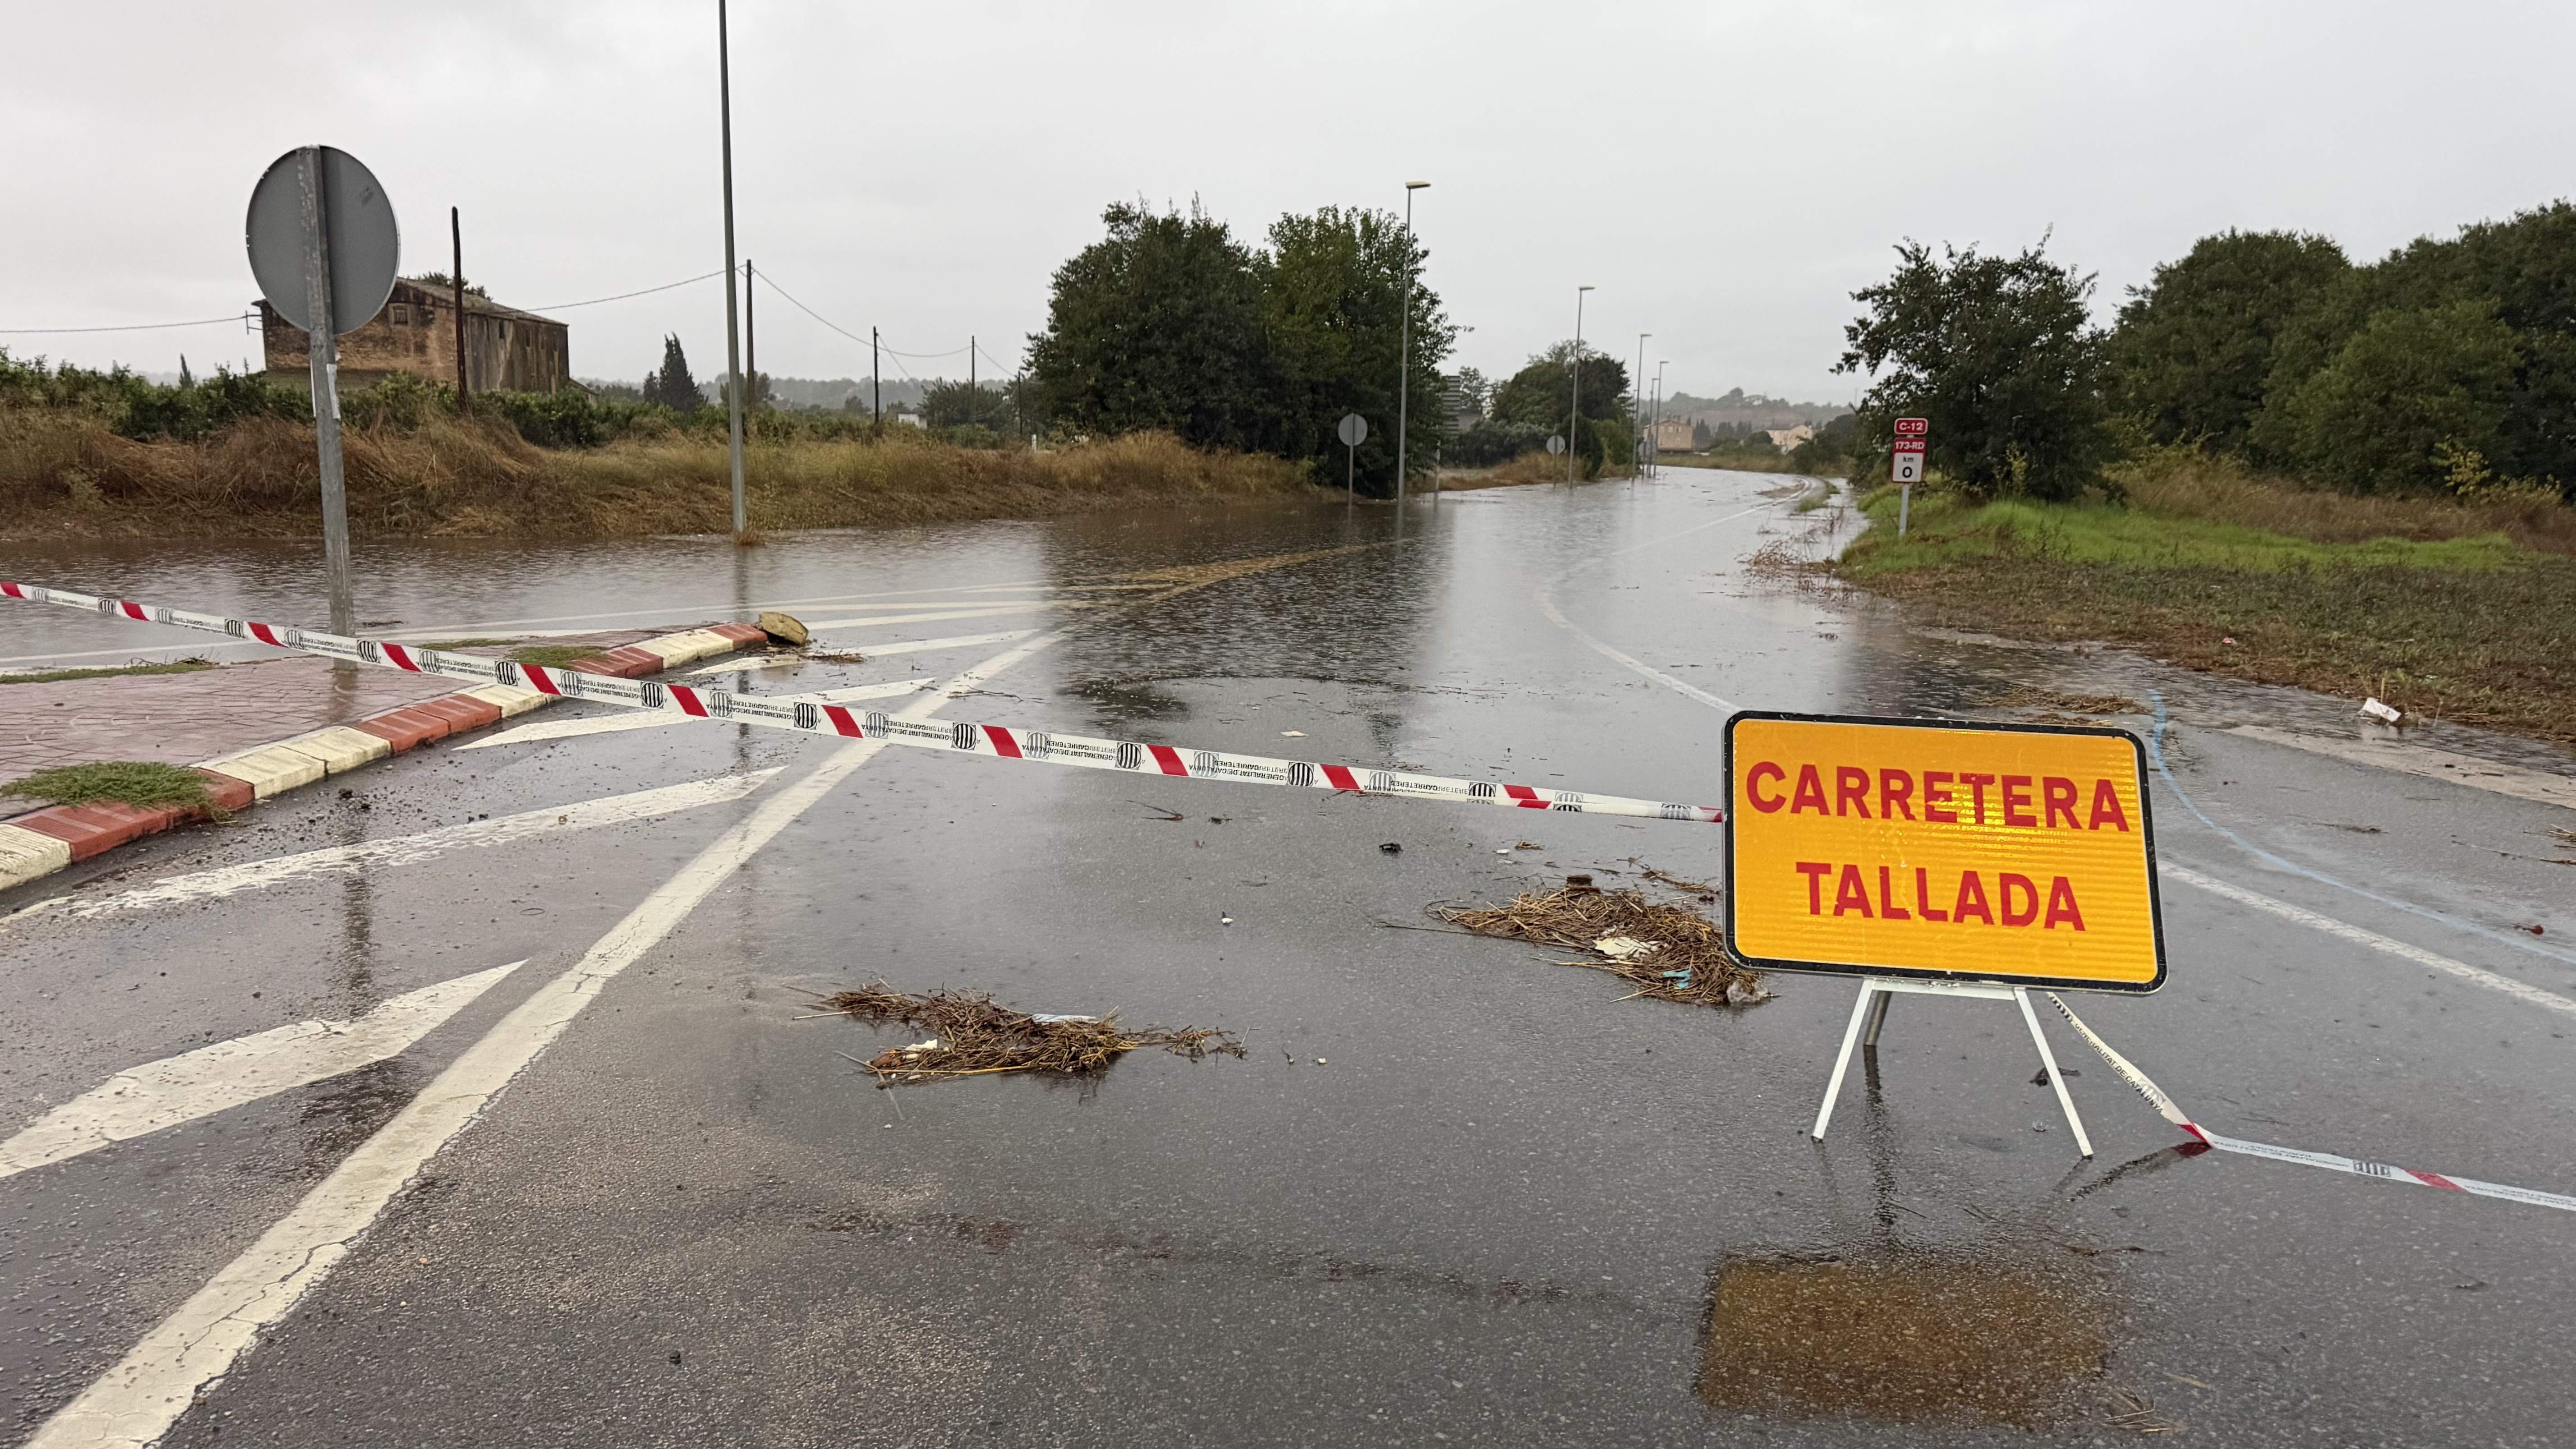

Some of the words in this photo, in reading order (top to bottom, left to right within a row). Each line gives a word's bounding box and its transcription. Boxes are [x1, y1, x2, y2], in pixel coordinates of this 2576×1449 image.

[1899, 422, 1923, 431] C-12
[1895, 442, 1924, 450] 173-RD
[1902, 466, 1912, 478] 0
[1746, 761, 2130, 832] CARRETERA
[1796, 862, 2086, 931] TALLADA
